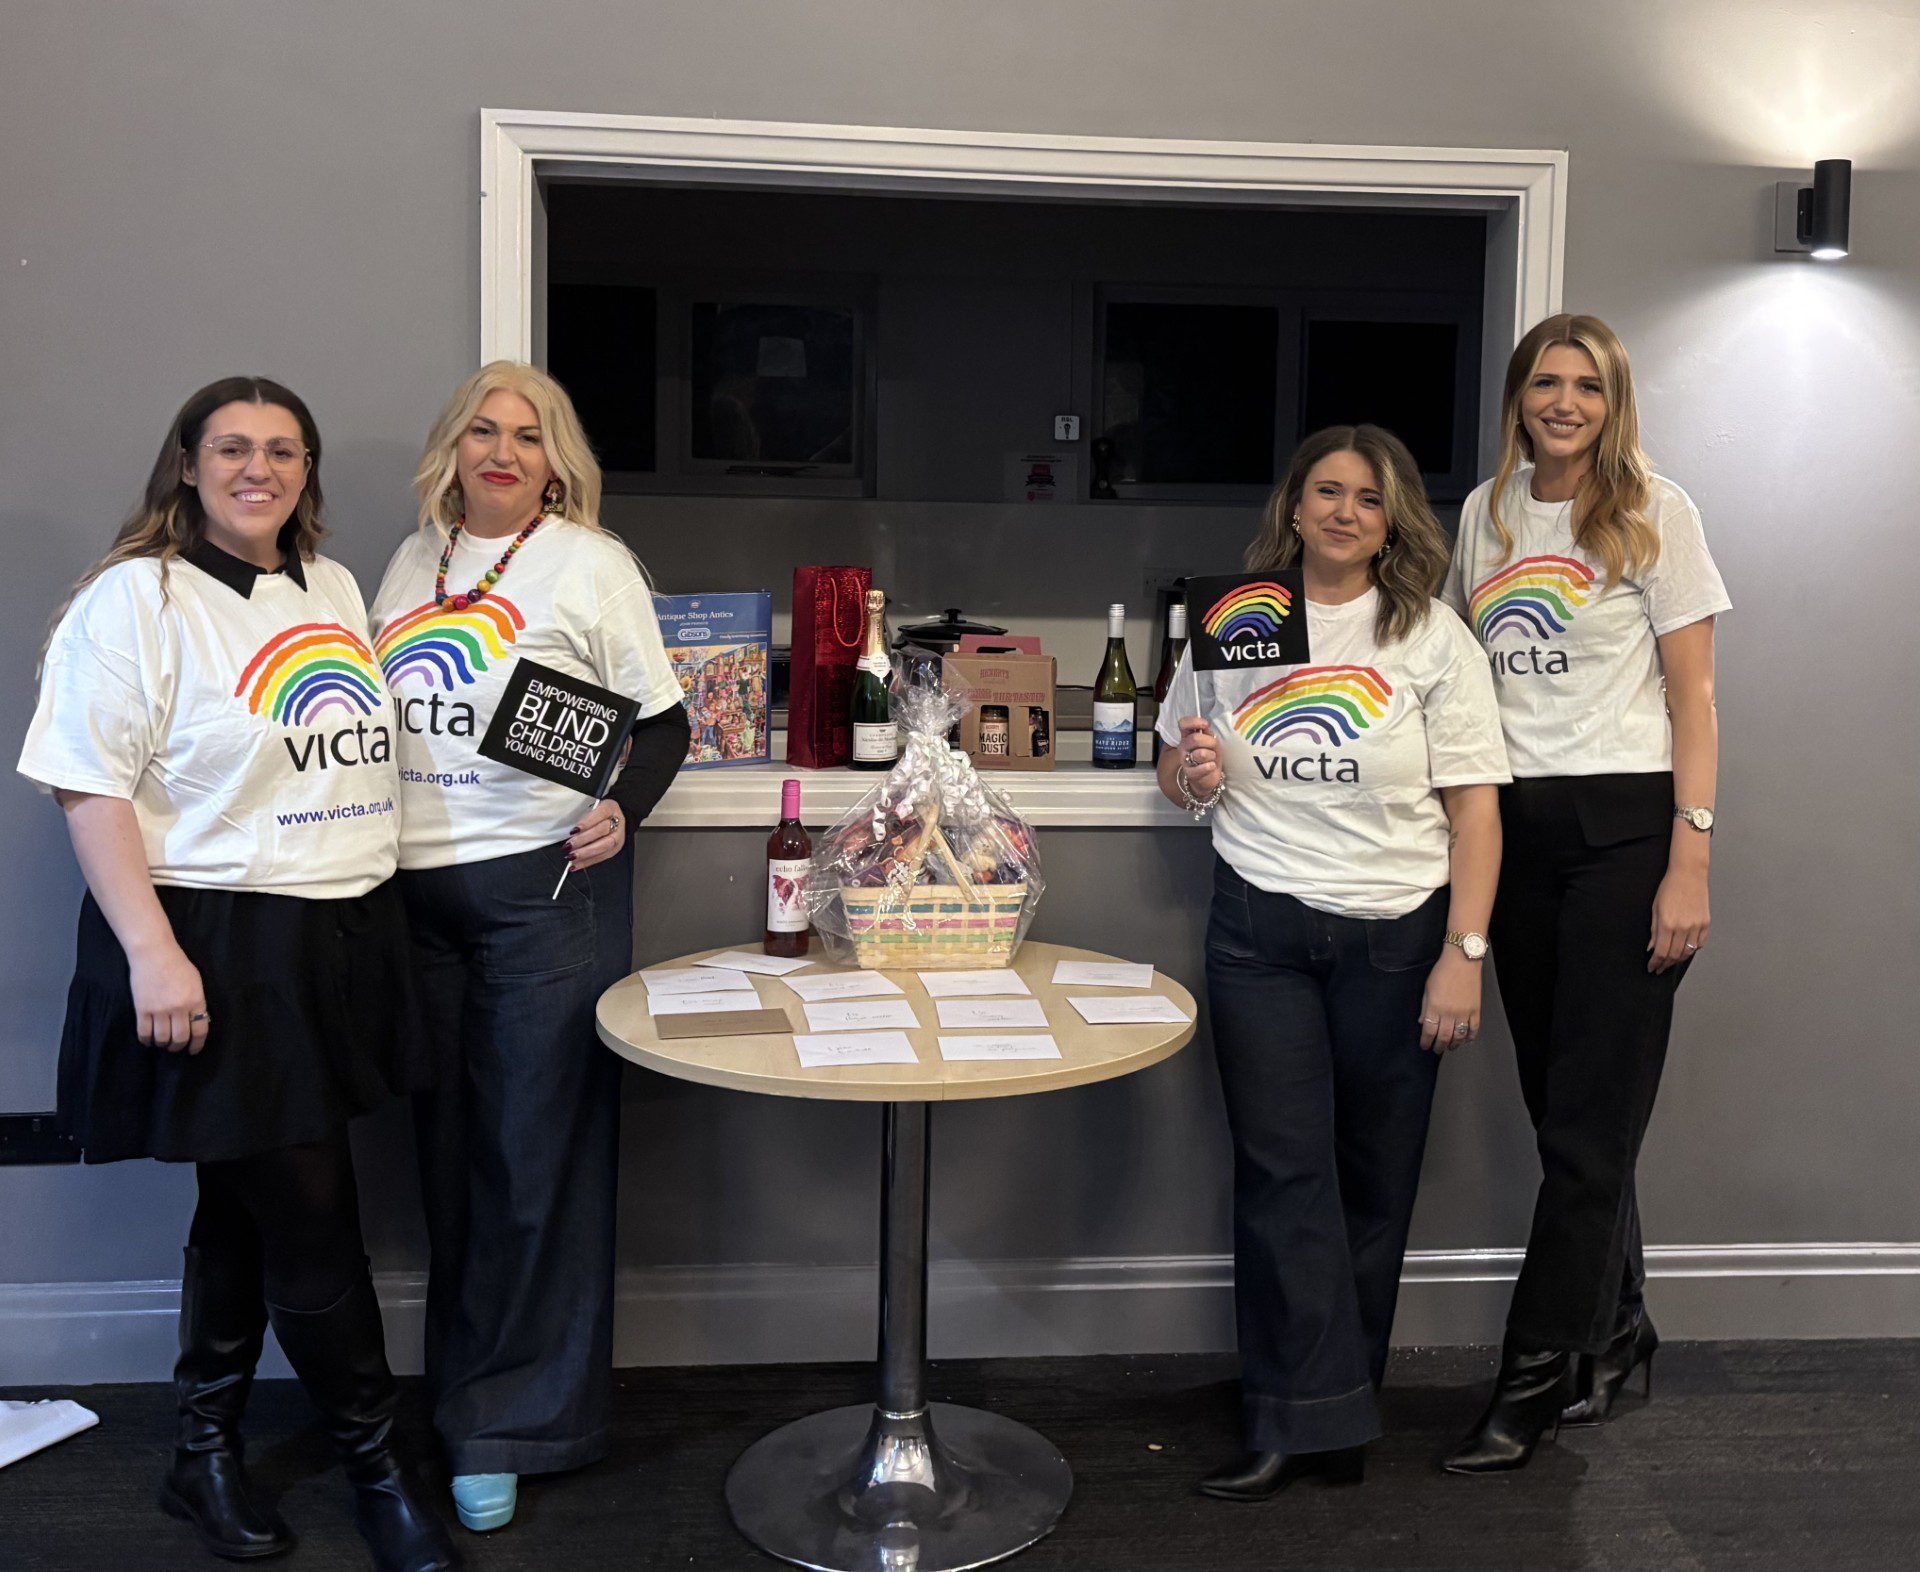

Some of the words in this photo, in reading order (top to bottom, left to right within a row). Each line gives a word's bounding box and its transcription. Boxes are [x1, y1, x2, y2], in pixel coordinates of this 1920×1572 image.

[656, 613, 686, 622] Antique
[687, 612, 708, 620] Shop
[709, 611, 734, 619] Antics
[1220, 639, 1280, 663] victa
[393, 692, 475, 737] icta
[528, 679, 618, 722] EMPOWERING
[515, 692, 610, 748] BLIND
[283, 719, 390, 772] victa
[509, 721, 600, 767] CHILDREN
[979, 732, 1008, 743] MAGIC
[981, 743, 1006, 753] DUST
[504, 737, 546, 761] YOUNG
[545, 755, 593, 779] ADULTS
[1253, 752, 1360, 783] victa
[398, 767, 481, 787] icta.org.uk
[276, 797, 394, 826] www.victa.org.uk
